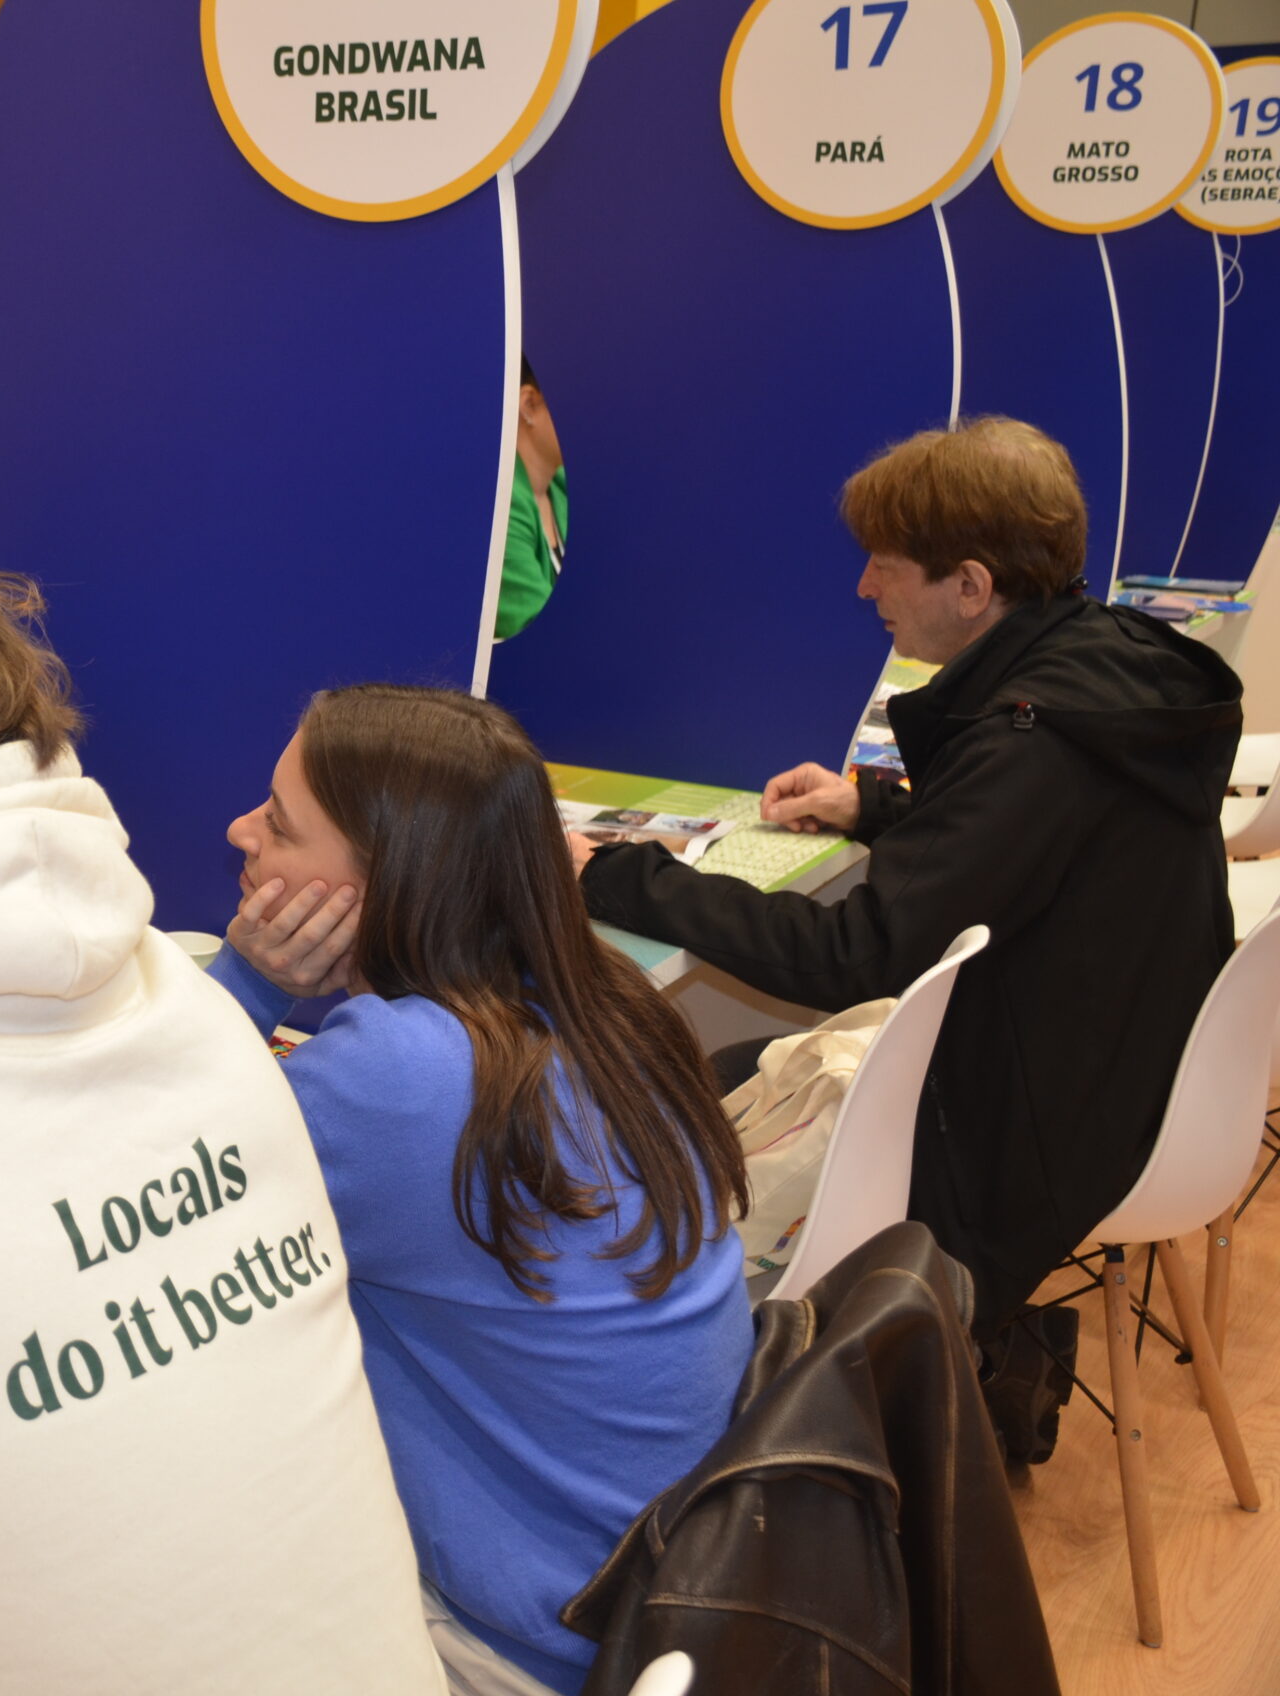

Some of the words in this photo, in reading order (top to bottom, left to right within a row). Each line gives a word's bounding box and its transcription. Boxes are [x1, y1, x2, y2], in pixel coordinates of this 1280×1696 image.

[819, 0, 909, 72] 17
[273, 36, 486, 78] GONDWANA
[314, 88, 437, 123] BRASIL
[1074, 61, 1145, 113] 18
[1228, 97, 1280, 137] 19
[815, 136, 885, 163] PARÁ
[1066, 141, 1131, 159] MATO
[1224, 148, 1273, 163] ROTA
[1052, 164, 1140, 184] GROSSO
[52, 1136, 248, 1273] Locals
[6, 1329, 106, 1422] do
[104, 1296, 174, 1381] it
[160, 1222, 332, 1351] better.
